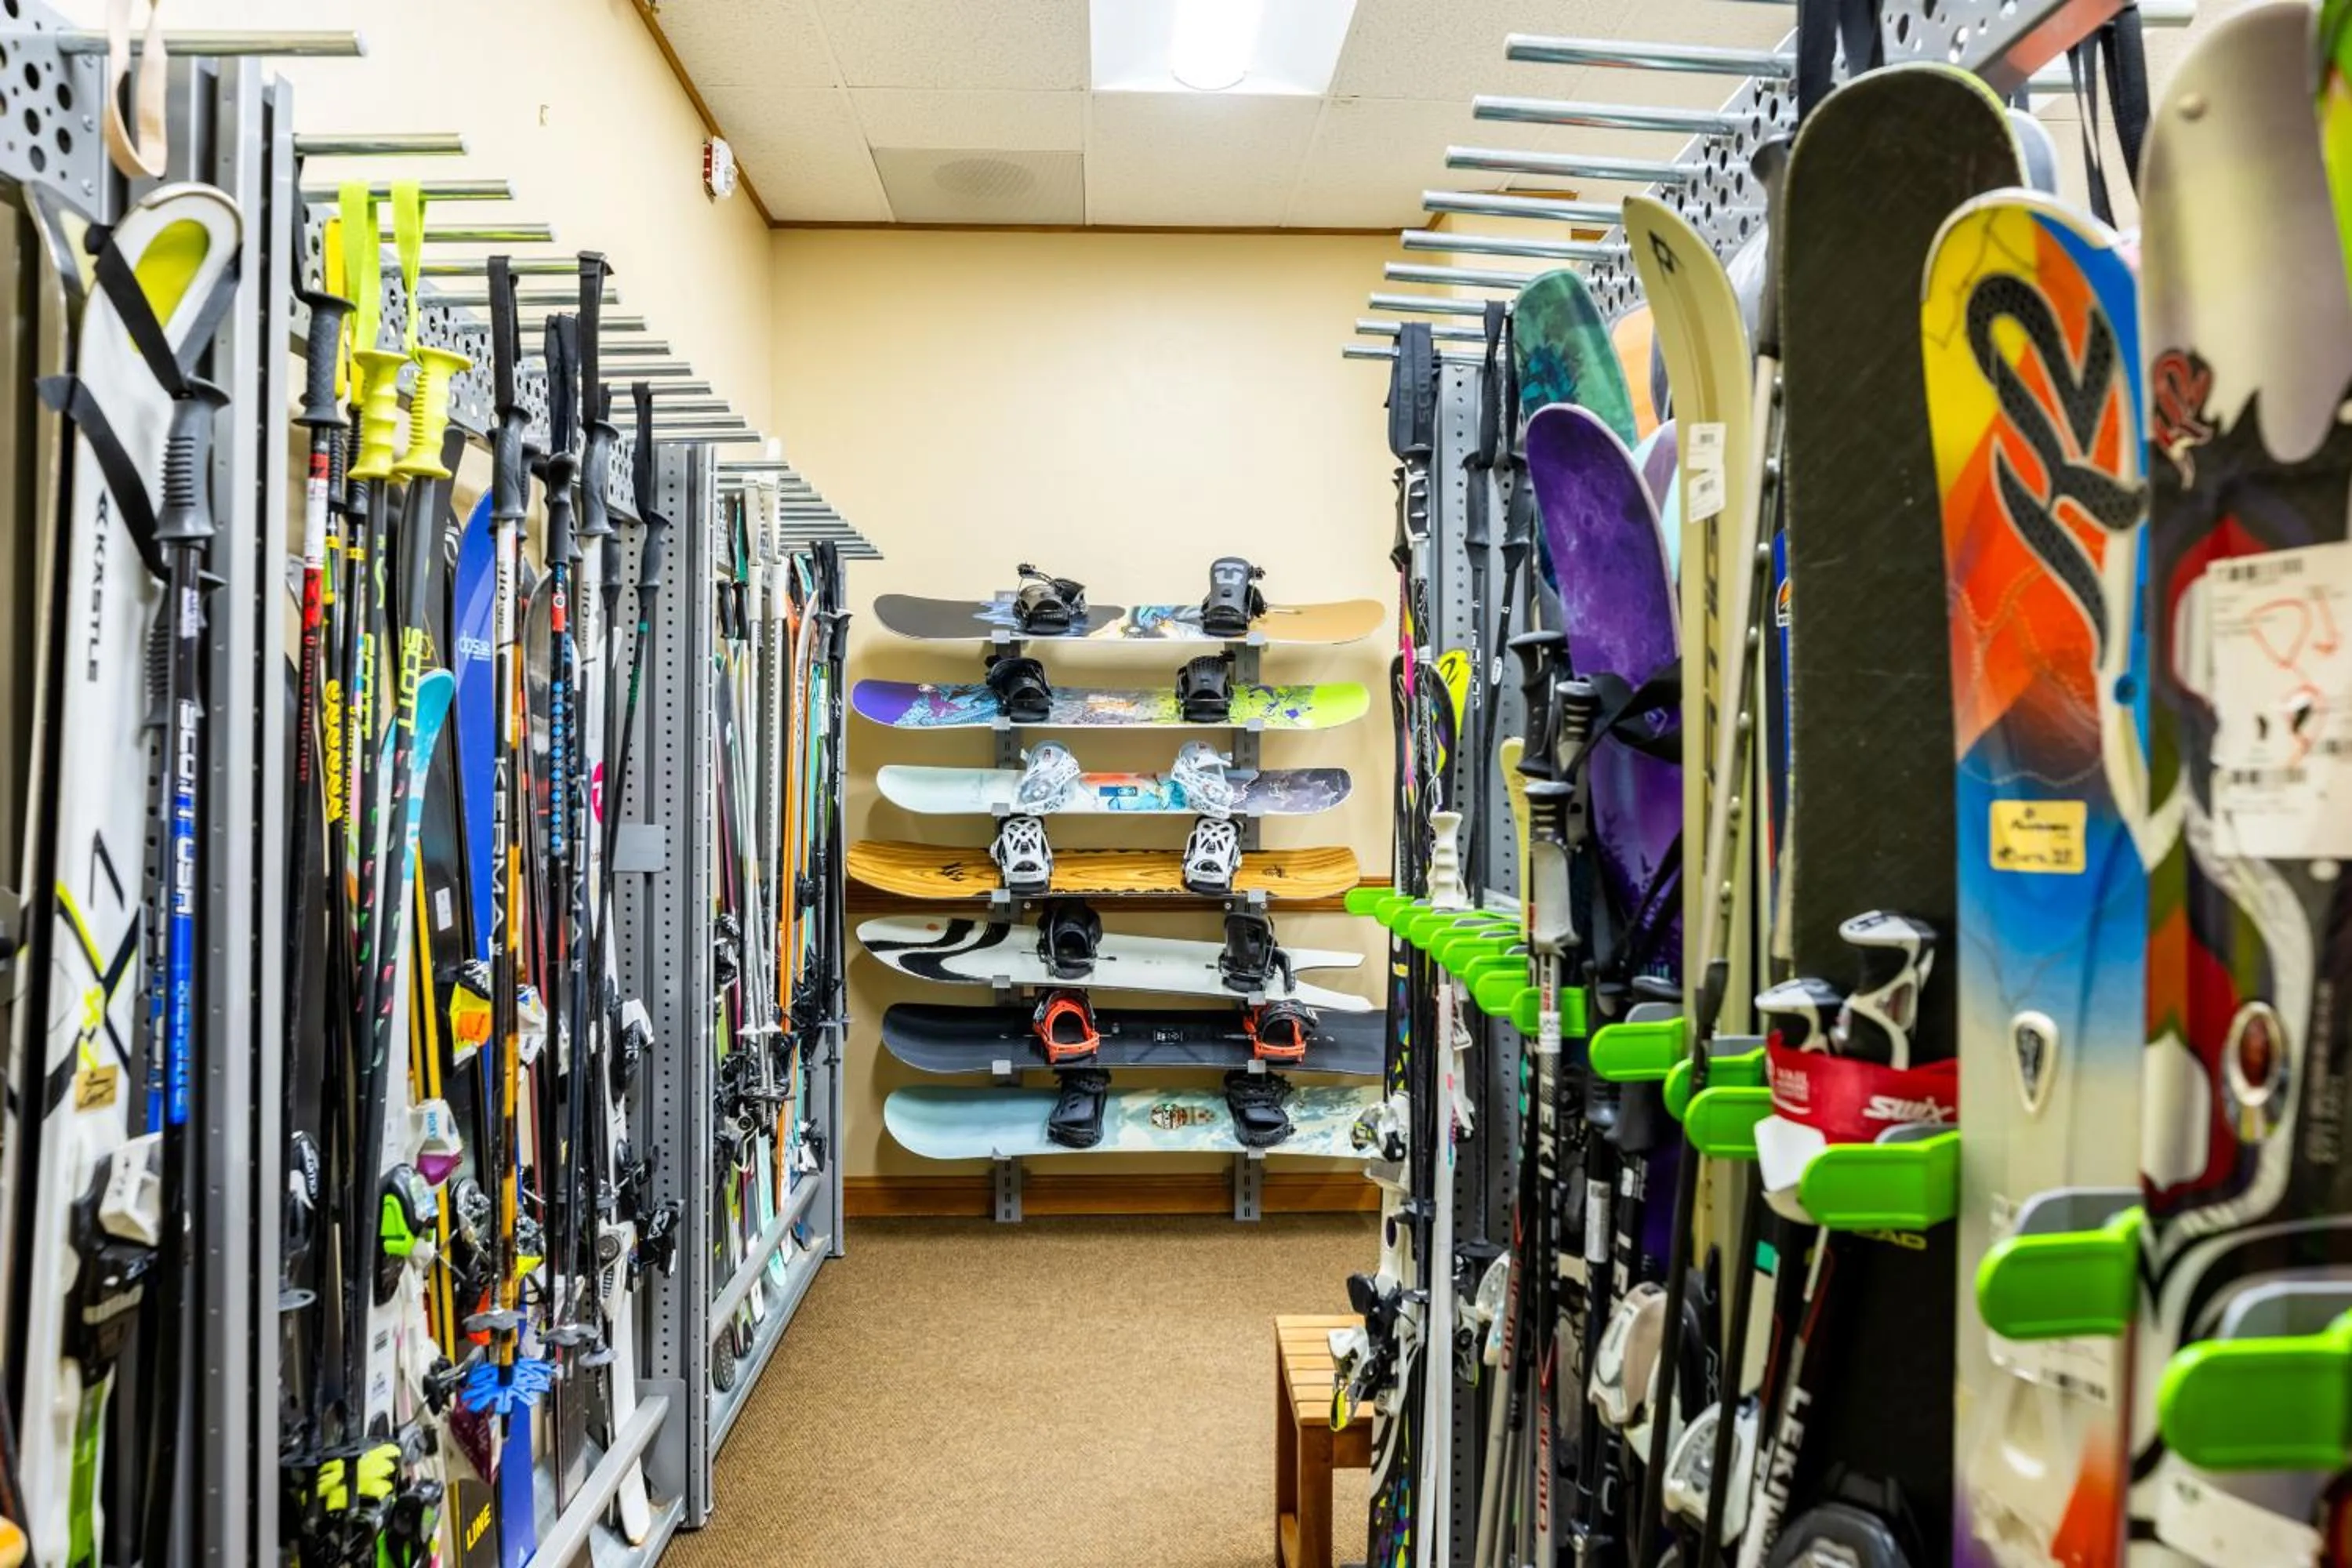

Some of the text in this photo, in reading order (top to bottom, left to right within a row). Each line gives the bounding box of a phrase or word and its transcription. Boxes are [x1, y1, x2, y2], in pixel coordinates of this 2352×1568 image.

[363, 633, 376, 740] SCOTT
[397, 626, 423, 736] SCOTT
[174, 699, 199, 916] SCOTT USA
[491, 757, 506, 940] KERMA
[571, 775, 586, 946] KERMA
[1538, 1073, 1555, 1179] LEKI
[1766, 1385, 1812, 1501] LEKI
[465, 1503, 492, 1552] LINE
